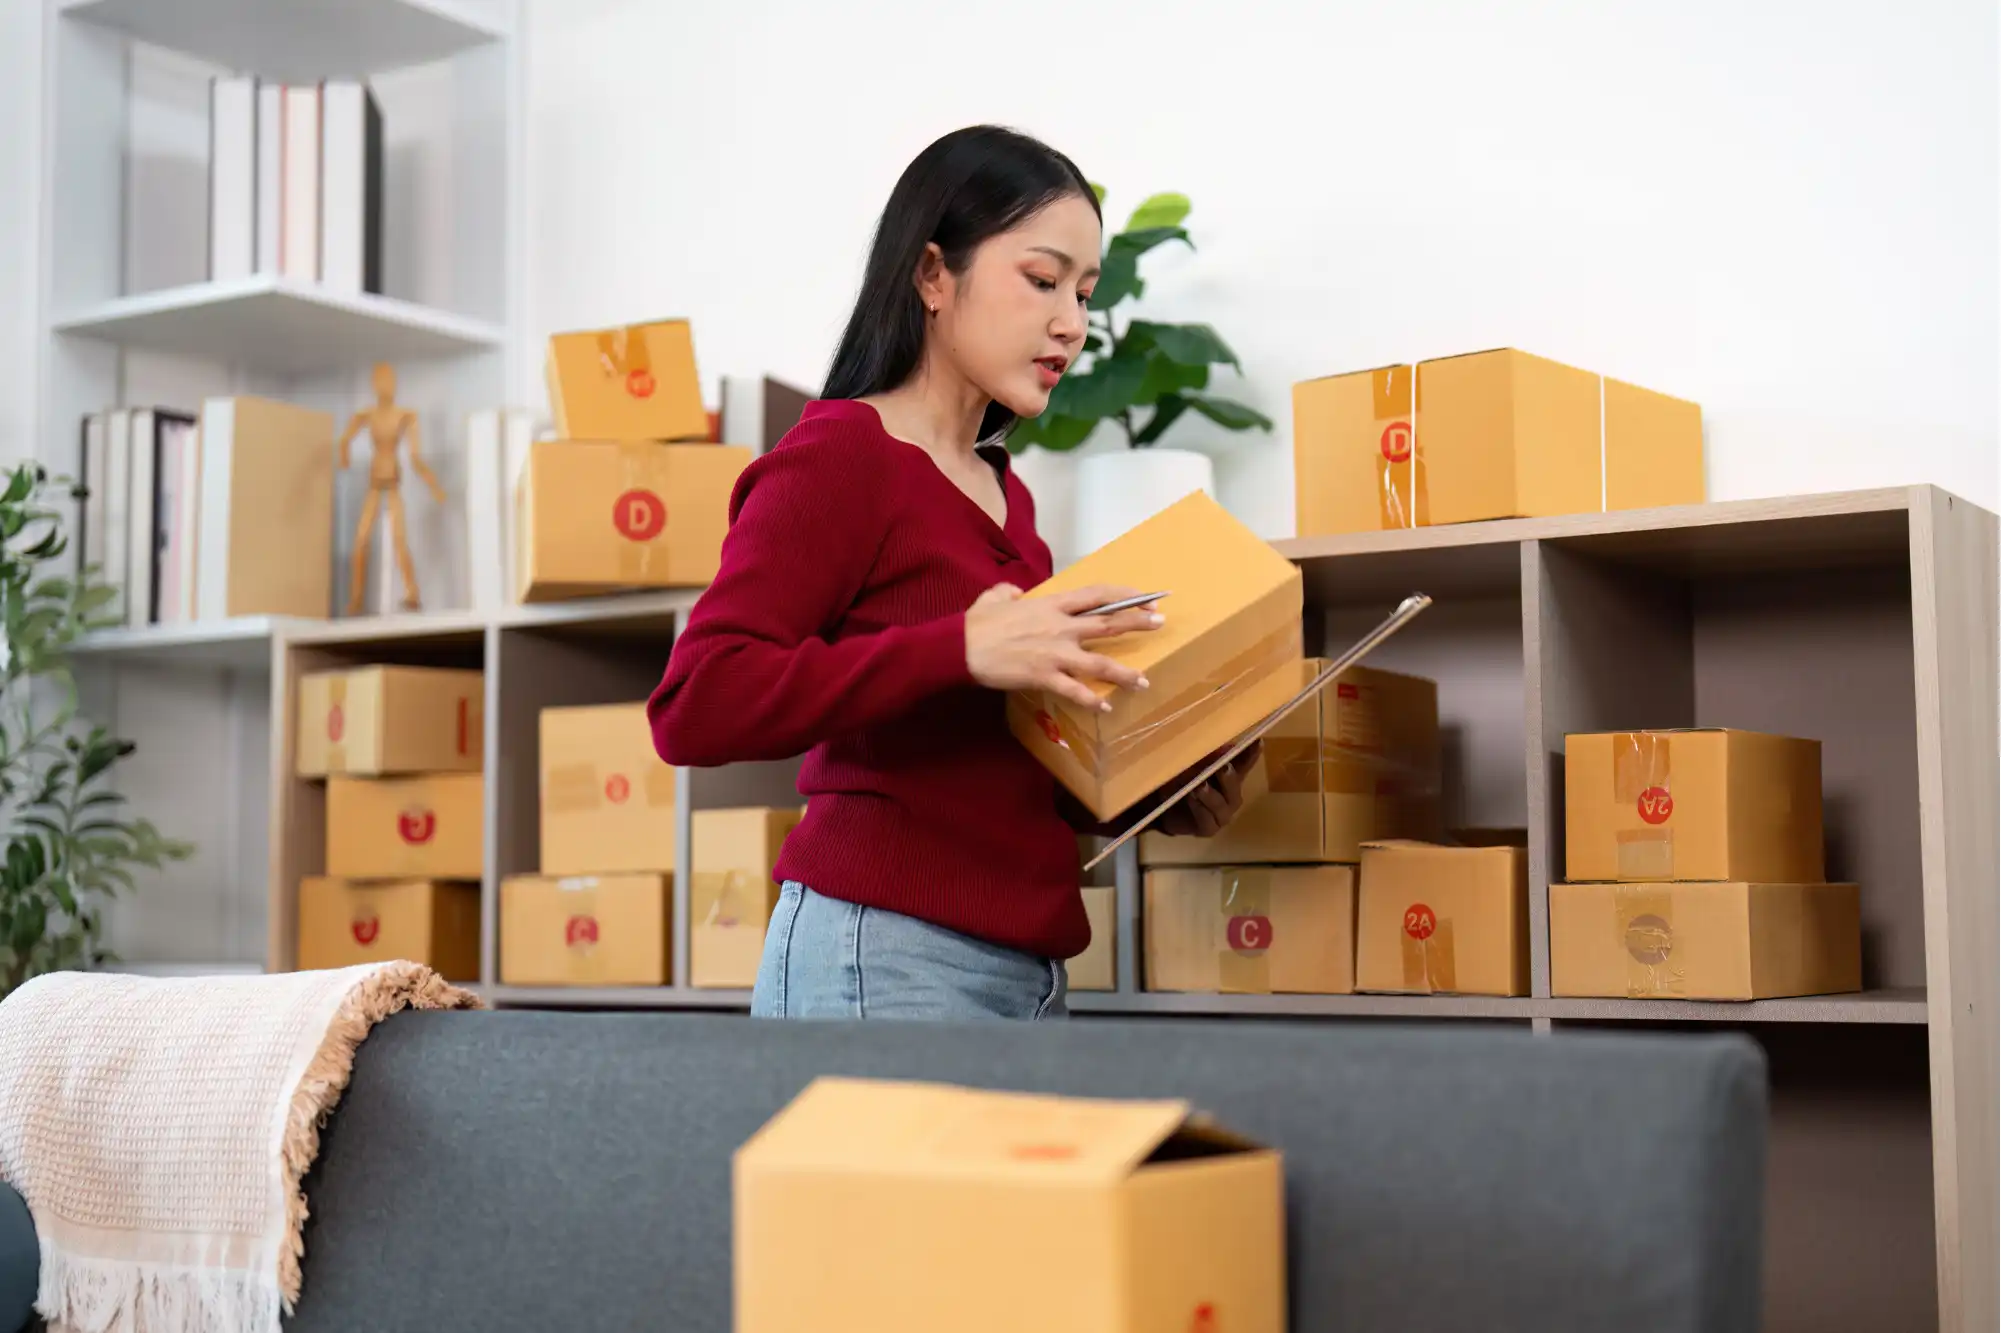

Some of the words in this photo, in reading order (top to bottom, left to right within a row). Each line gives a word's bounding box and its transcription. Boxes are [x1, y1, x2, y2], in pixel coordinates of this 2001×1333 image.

[1389, 428, 1411, 455] D
[629, 500, 651, 530] D
[1642, 796, 1669, 815] 2A
[1240, 920, 1259, 947] C
[1407, 912, 1432, 930] 2A
